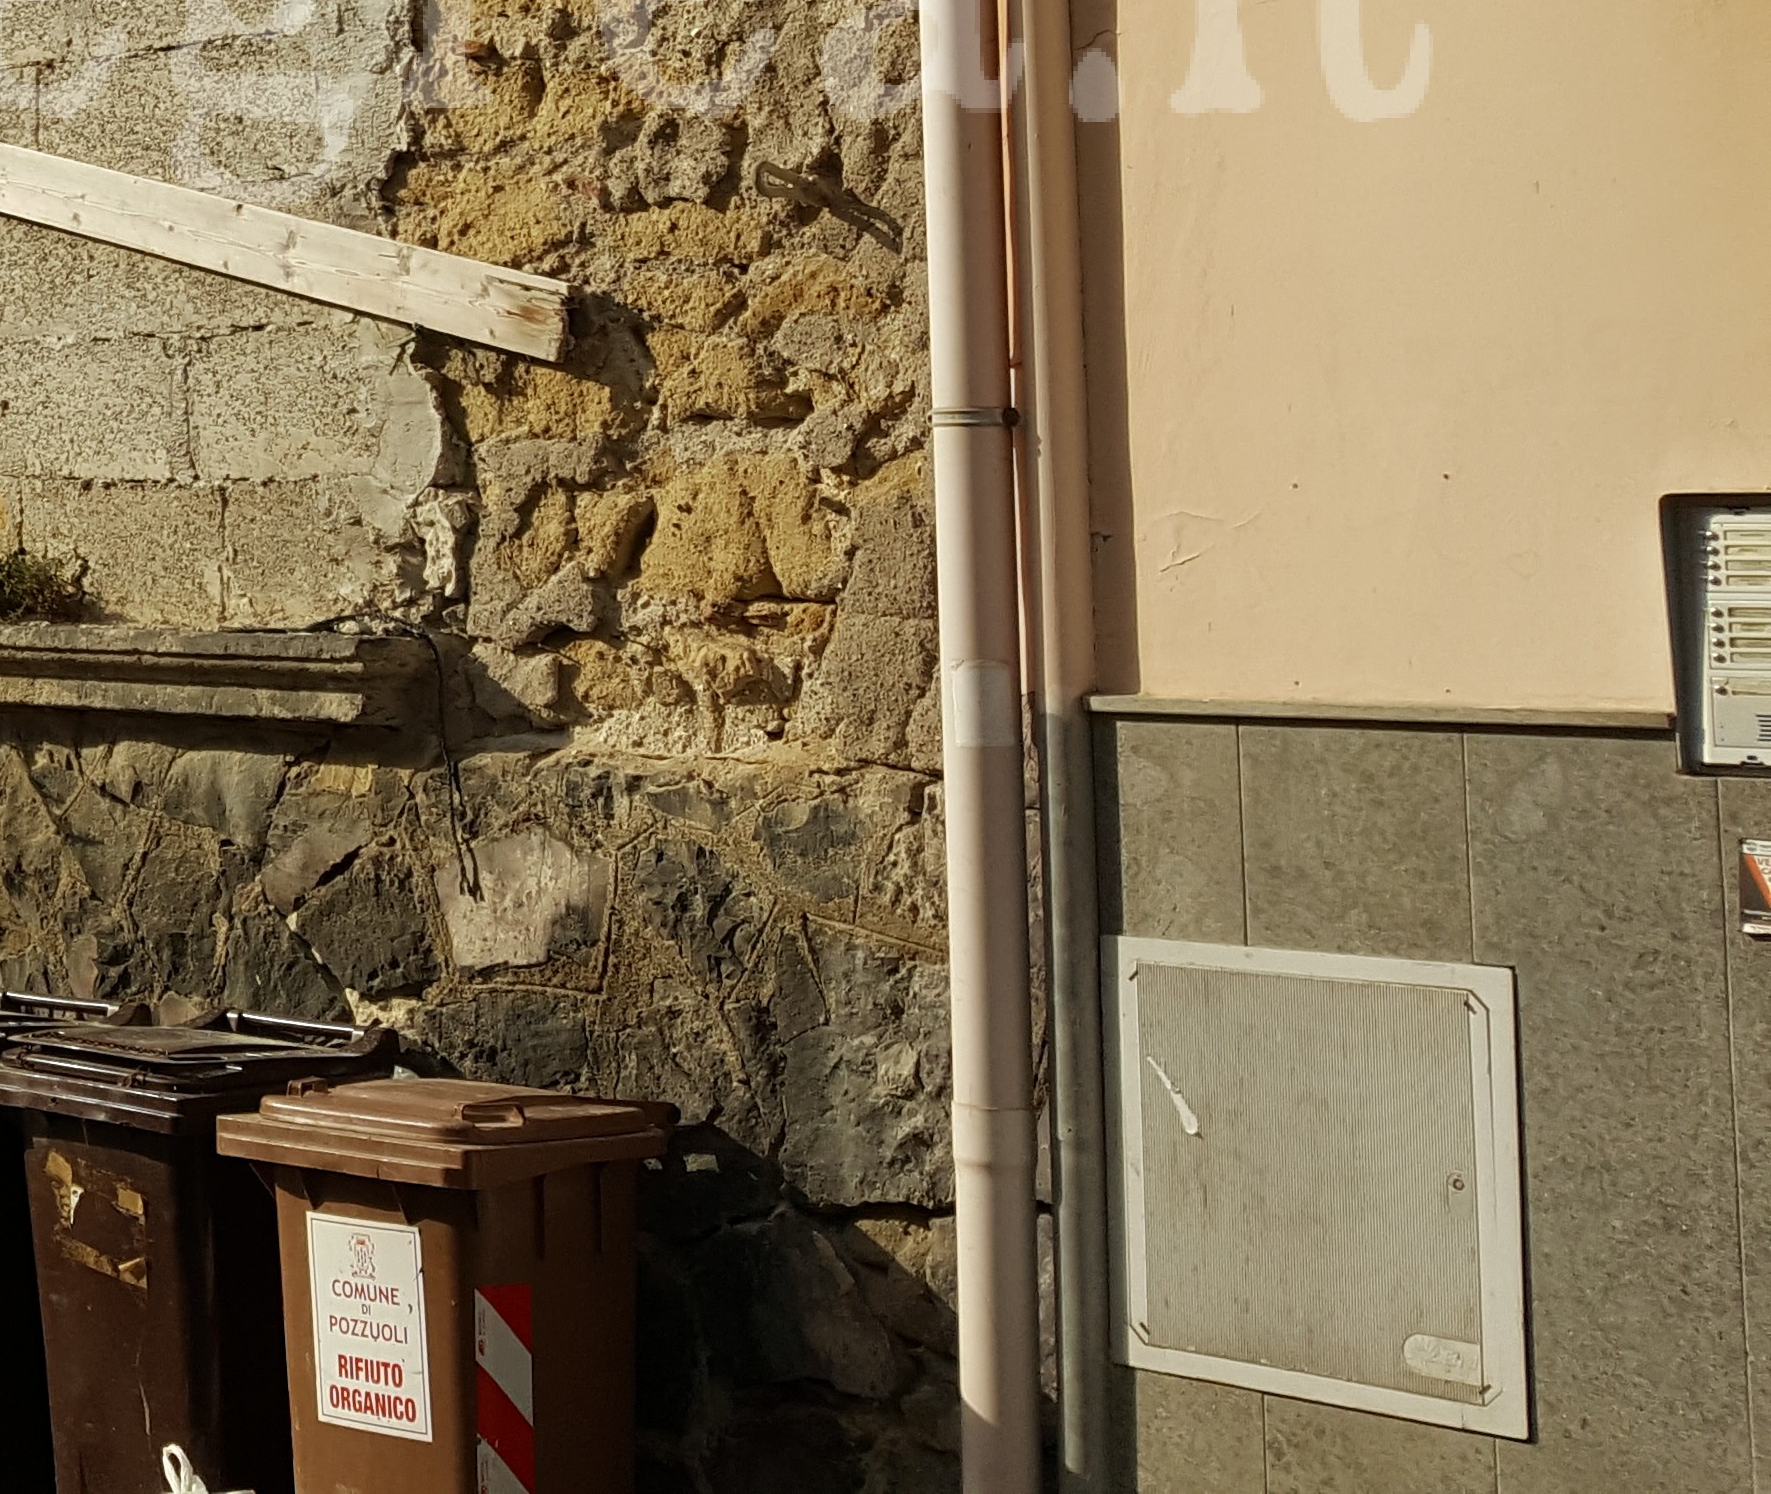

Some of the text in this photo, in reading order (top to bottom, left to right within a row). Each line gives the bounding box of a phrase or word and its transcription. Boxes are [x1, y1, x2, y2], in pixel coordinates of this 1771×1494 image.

[331, 1279, 400, 1306] COMUNE
[361, 1303, 372, 1316] DI
[329, 1315, 408, 1345] POZZUOLI
[338, 1354, 403, 1388] RIFIUTO
[329, 1384, 417, 1423] ORGANICO
